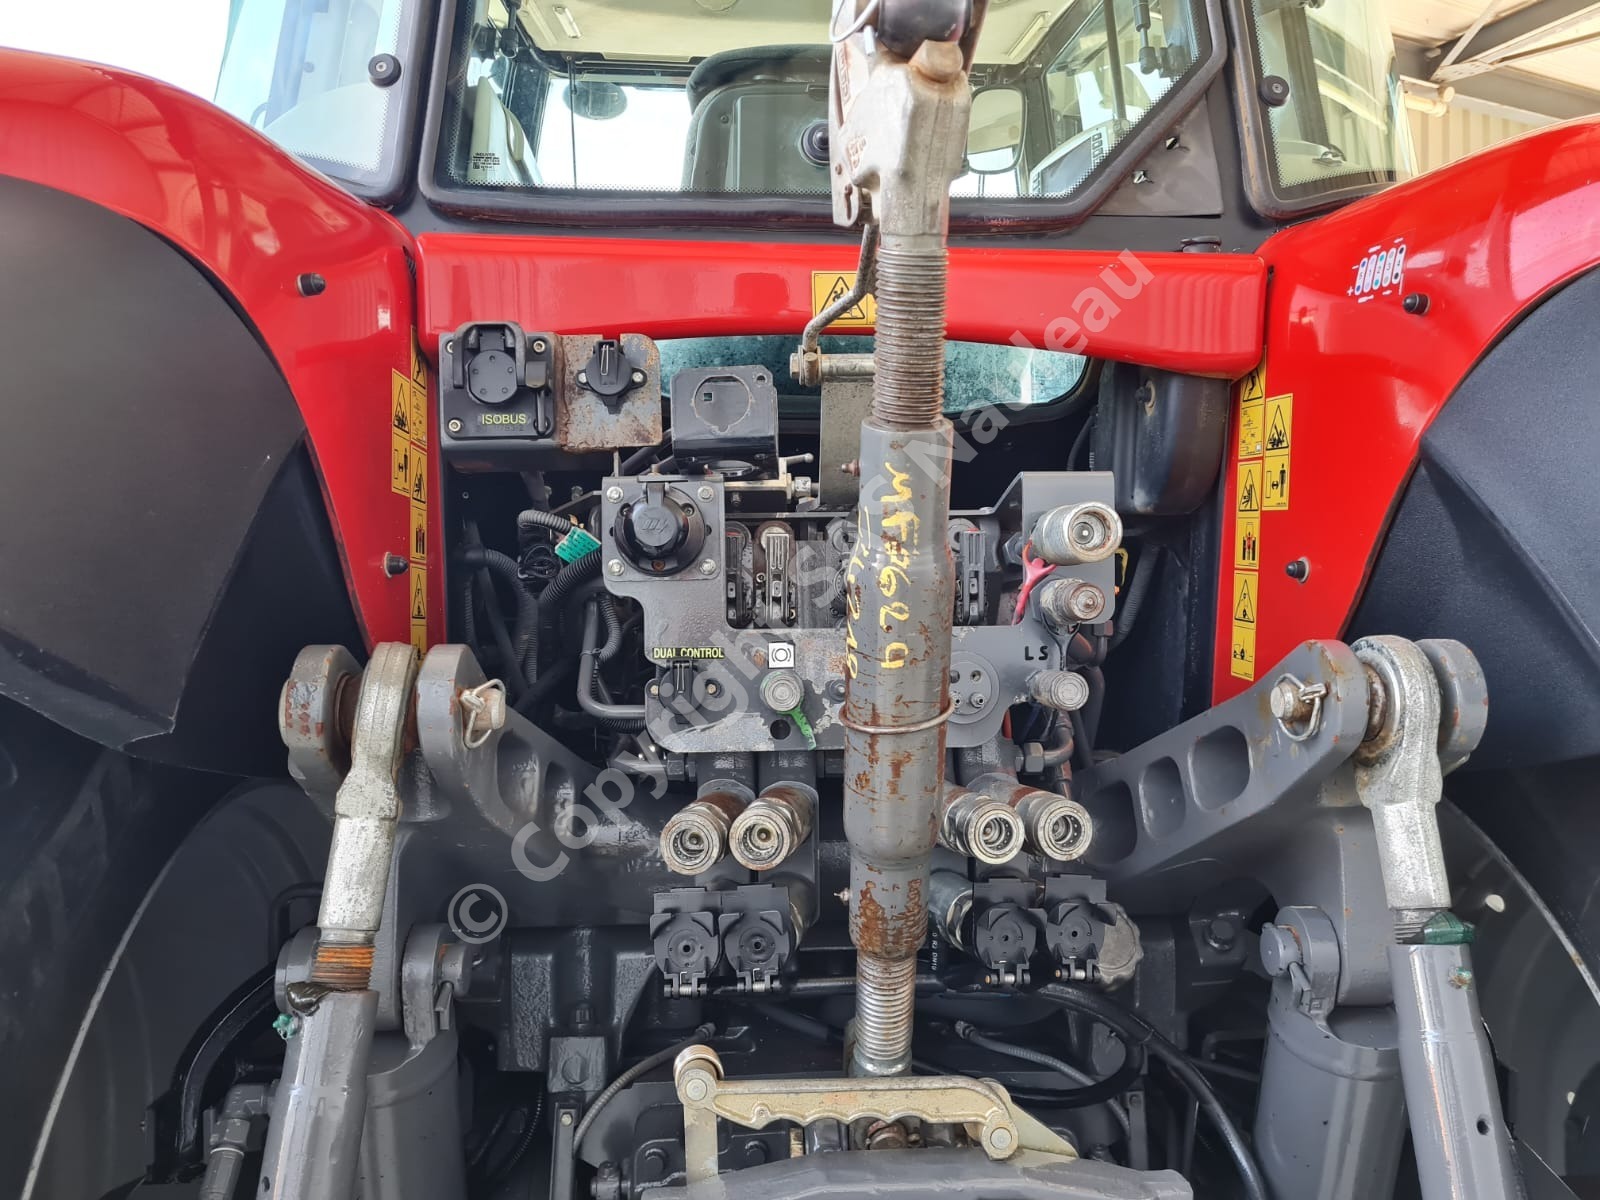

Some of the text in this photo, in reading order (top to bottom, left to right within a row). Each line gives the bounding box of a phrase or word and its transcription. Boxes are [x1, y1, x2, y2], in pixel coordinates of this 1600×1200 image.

[481, 413, 527, 424] ISOBUS
[653, 647, 724, 658] DUAL CONTROL
